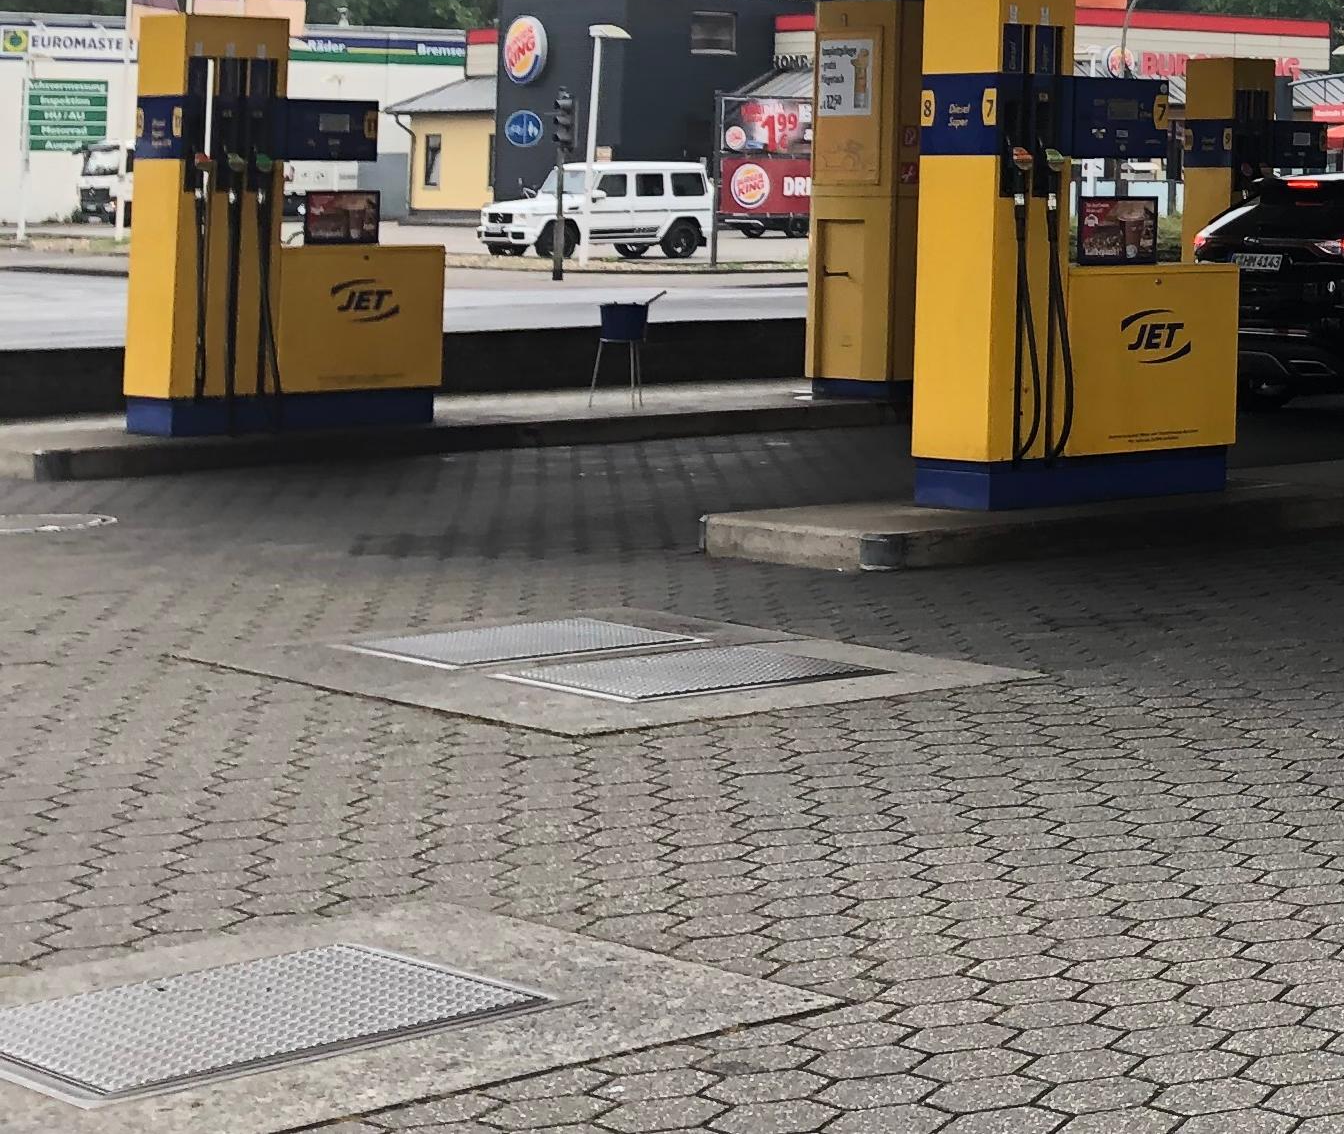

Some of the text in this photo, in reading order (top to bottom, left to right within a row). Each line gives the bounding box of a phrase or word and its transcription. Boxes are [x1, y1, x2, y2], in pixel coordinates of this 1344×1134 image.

[307, 39, 346, 54] Räder
[924, 99, 932, 117] 8
[985, 99, 994, 117] 7
[1157, 103, 1166, 121] 7
[337, 288, 393, 312] JET
[1128, 322, 1185, 351] JET
